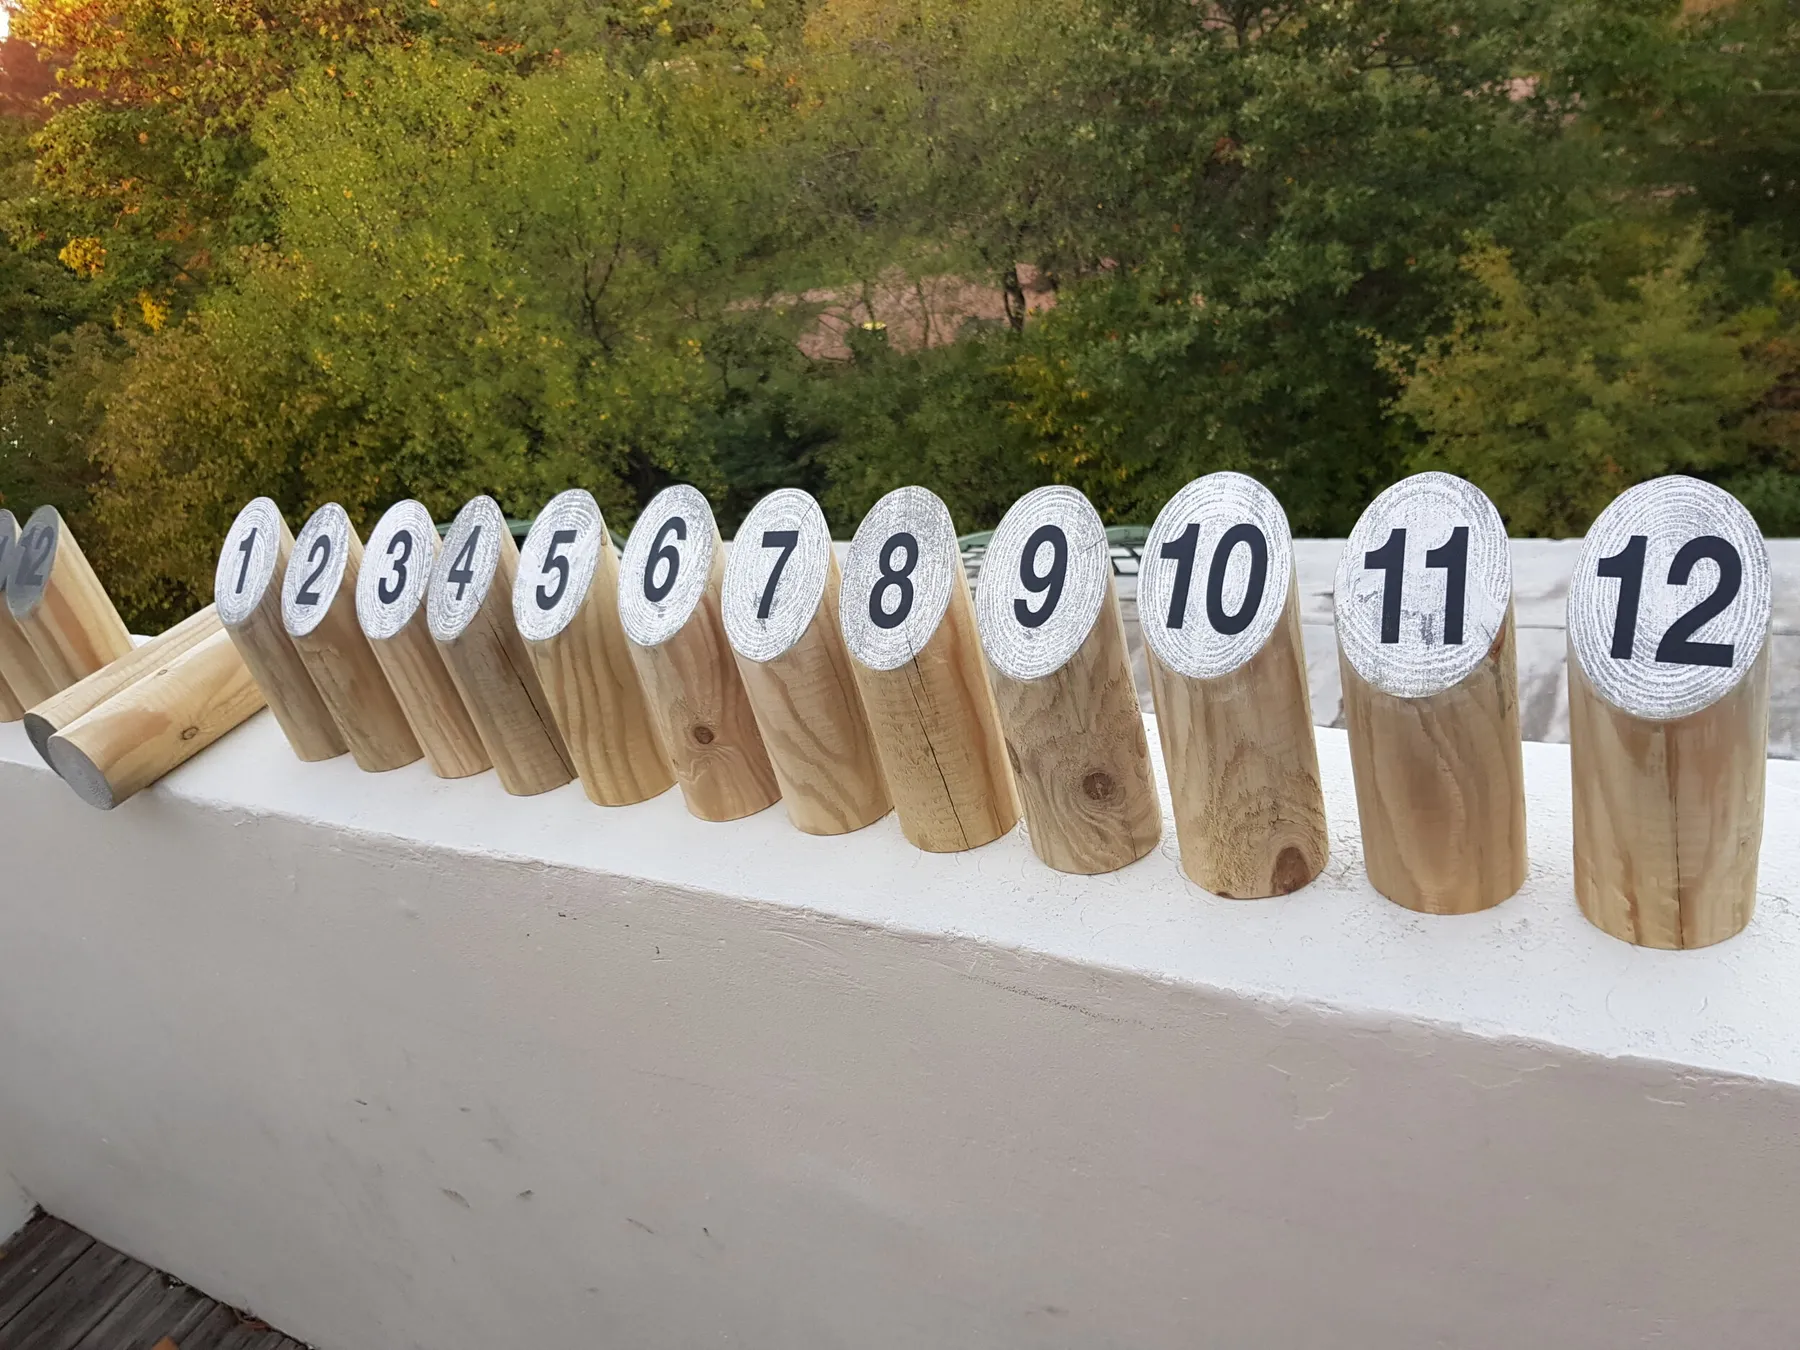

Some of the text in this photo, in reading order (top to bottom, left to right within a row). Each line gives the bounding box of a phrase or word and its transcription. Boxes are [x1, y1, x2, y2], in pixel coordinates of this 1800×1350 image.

[15, 526, 54, 586] 12
[236, 528, 257, 593] 1
[296, 535, 330, 605] 2
[379, 530, 412, 604] 3
[448, 526, 481, 600] 4
[536, 530, 576, 610] 5
[644, 517, 686, 602] 6
[757, 531, 799, 618] 7
[869, 532, 918, 629] 8
[1014, 525, 1067, 628] 9
[1160, 524, 1267, 635] 10
[1365, 527, 1469, 645] 11
[1597, 536, 1742, 668] 12
